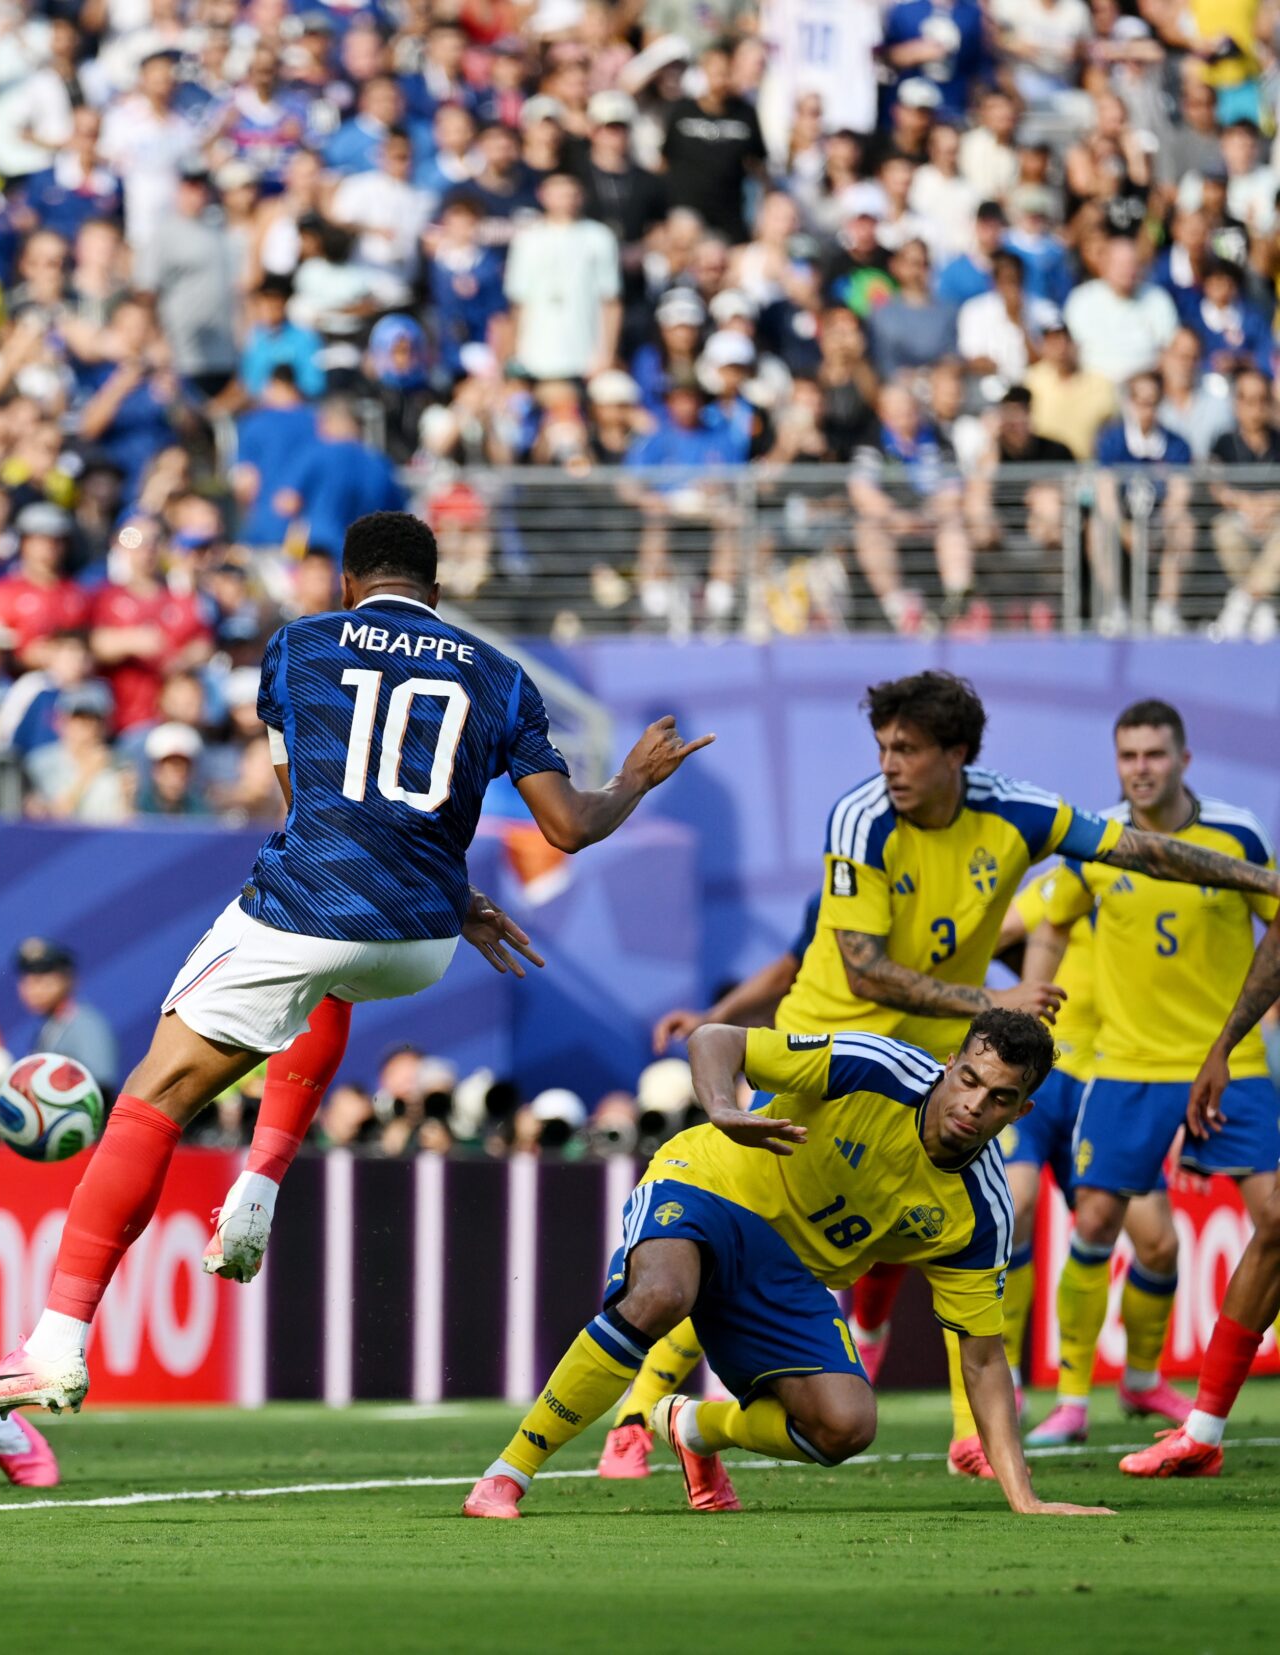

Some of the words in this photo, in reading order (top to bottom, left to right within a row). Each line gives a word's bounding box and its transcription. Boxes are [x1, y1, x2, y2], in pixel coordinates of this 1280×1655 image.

[339, 622, 475, 665] MBAPPE
[340, 668, 471, 813] 10
[931, 917, 956, 965] 3
[1155, 911, 1177, 957] 5
[807, 1194, 873, 1250] 18
[543, 1388, 584, 1427] SVERIGE
